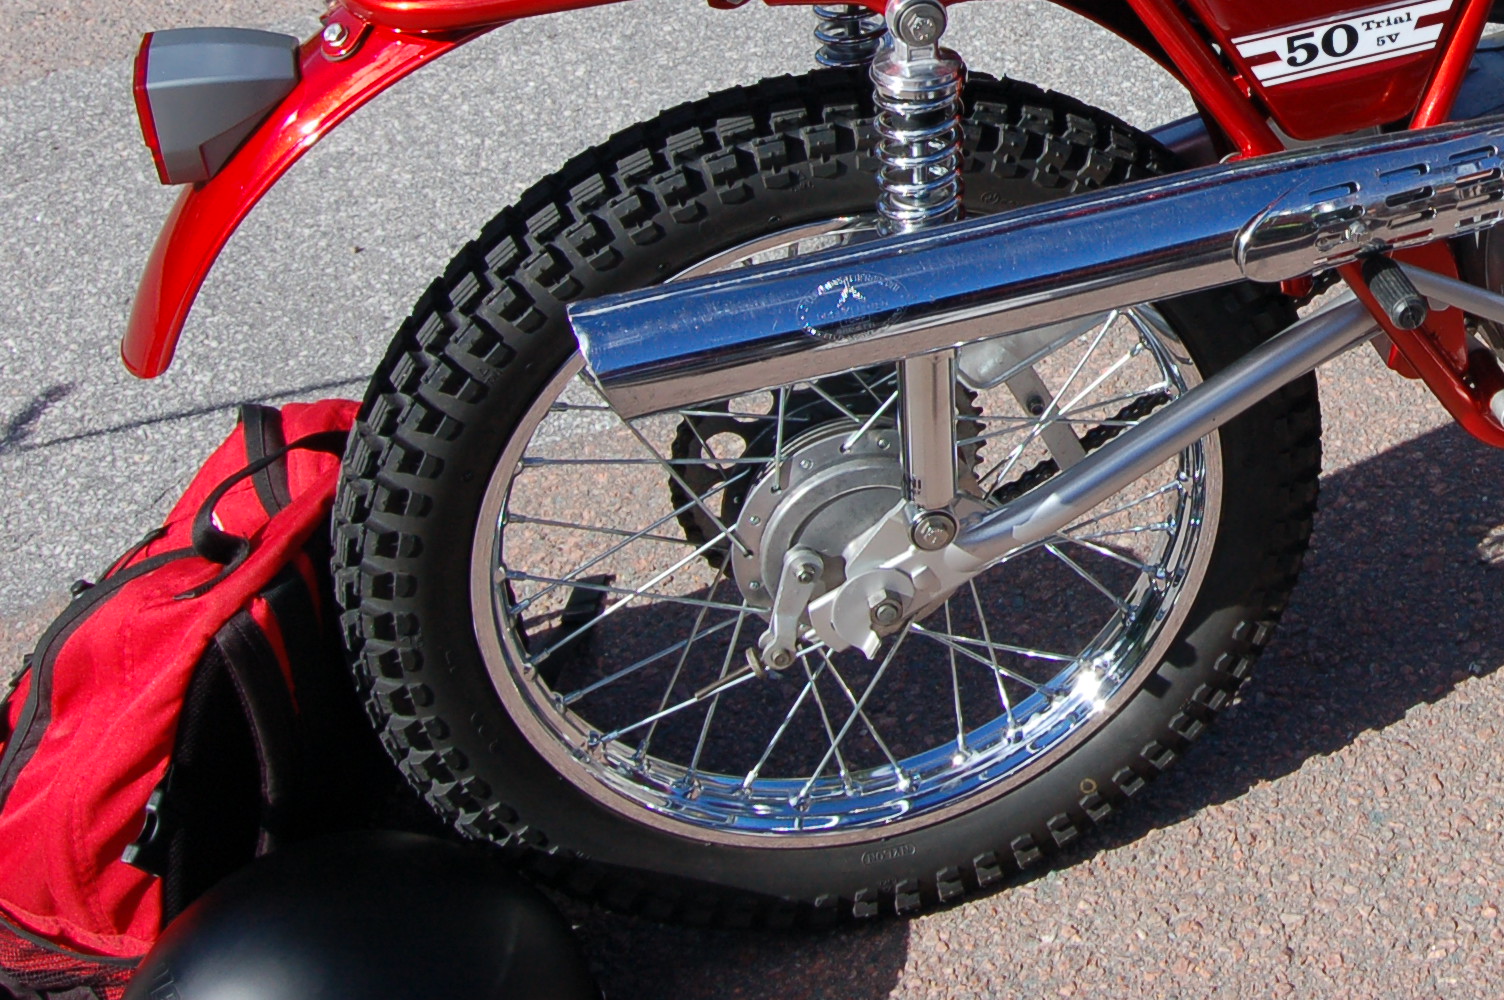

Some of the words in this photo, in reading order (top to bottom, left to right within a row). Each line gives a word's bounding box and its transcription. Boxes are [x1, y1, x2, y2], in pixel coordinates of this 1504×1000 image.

[1286, 23, 1359, 67] 50
[1361, 12, 1412, 32] Trial
[1376, 32, 1401, 47] 5V
